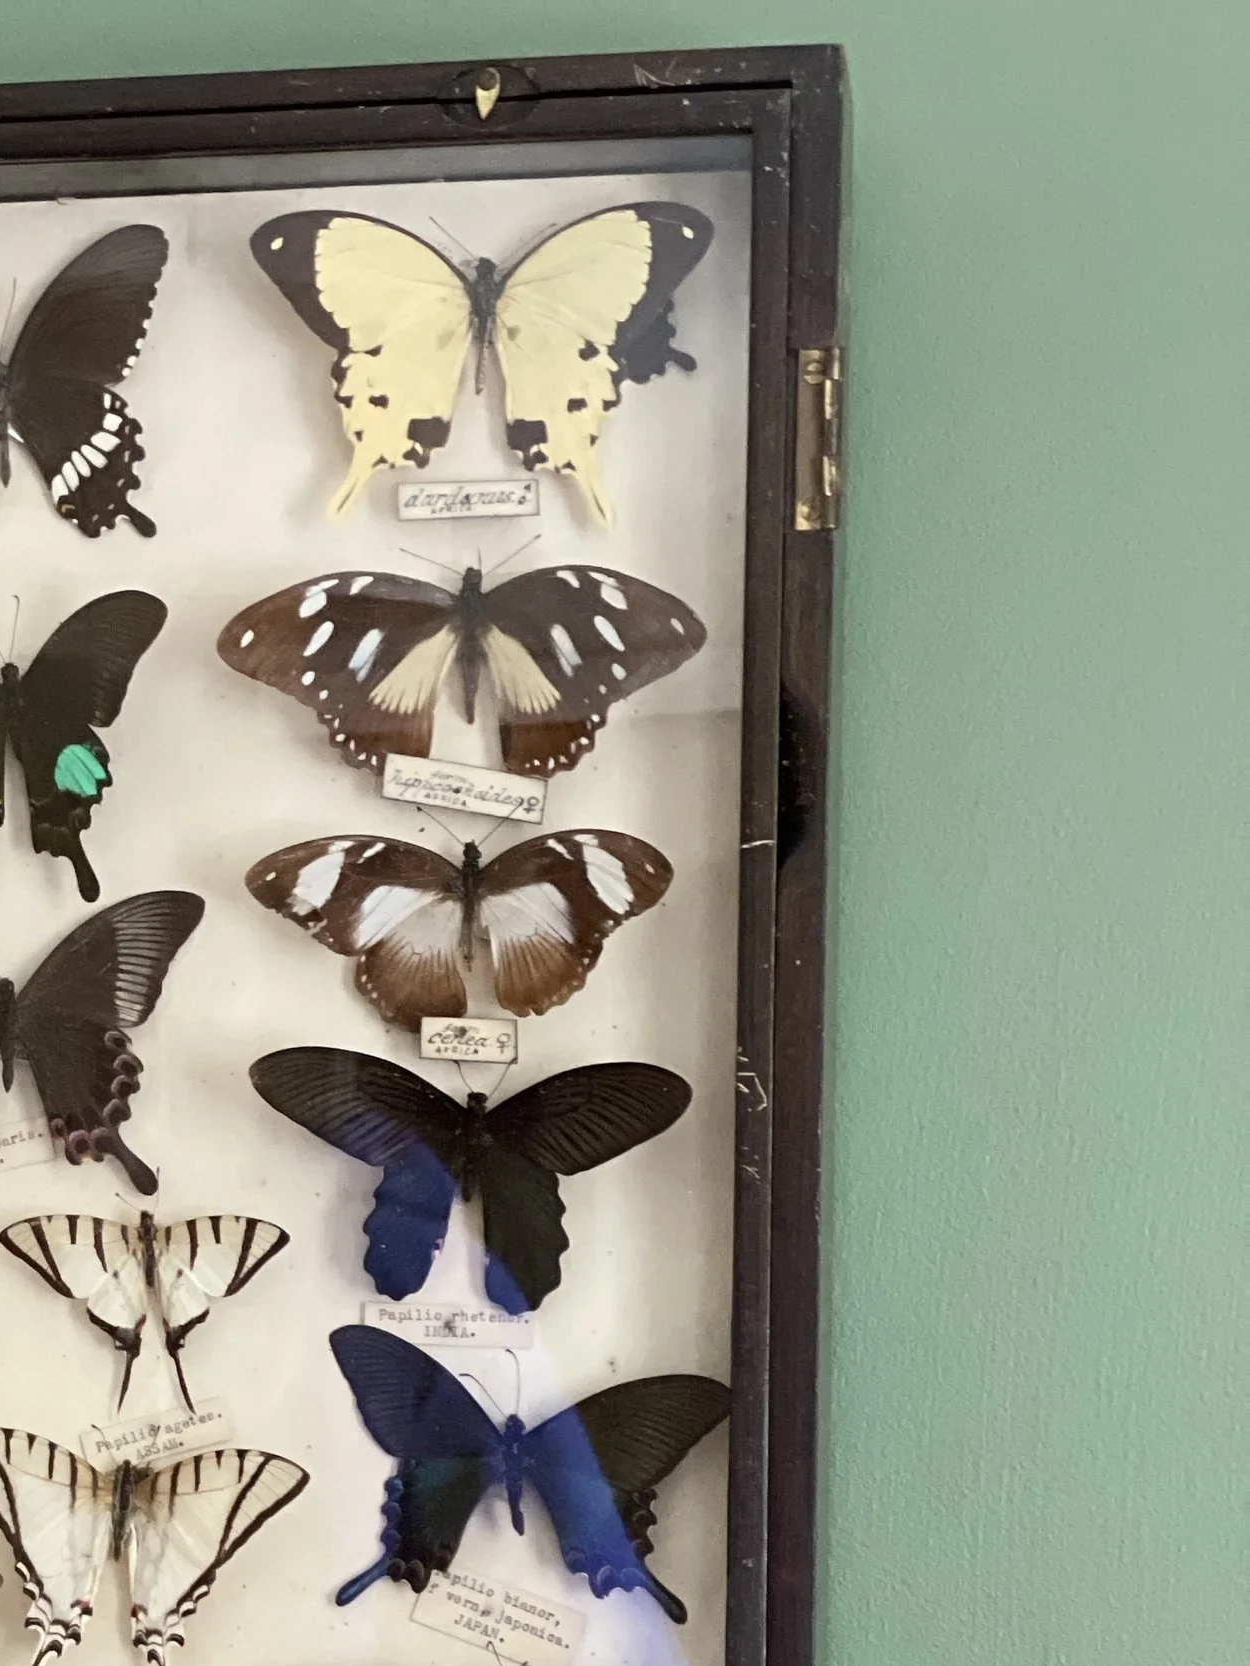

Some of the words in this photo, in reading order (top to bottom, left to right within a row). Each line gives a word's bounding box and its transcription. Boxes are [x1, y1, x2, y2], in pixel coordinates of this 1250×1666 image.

[378, 1308, 442, 1326] Papilio
[451, 1309, 529, 1325] rhetenor.
[424, 1325, 475, 1339] INDIA.
[95, 1421, 159, 1454] Papilio
[164, 1411, 223, 1436] agetes.
[454, 1613, 506, 1643] JAPAN.
[495, 1607, 570, 1650] japonica.
